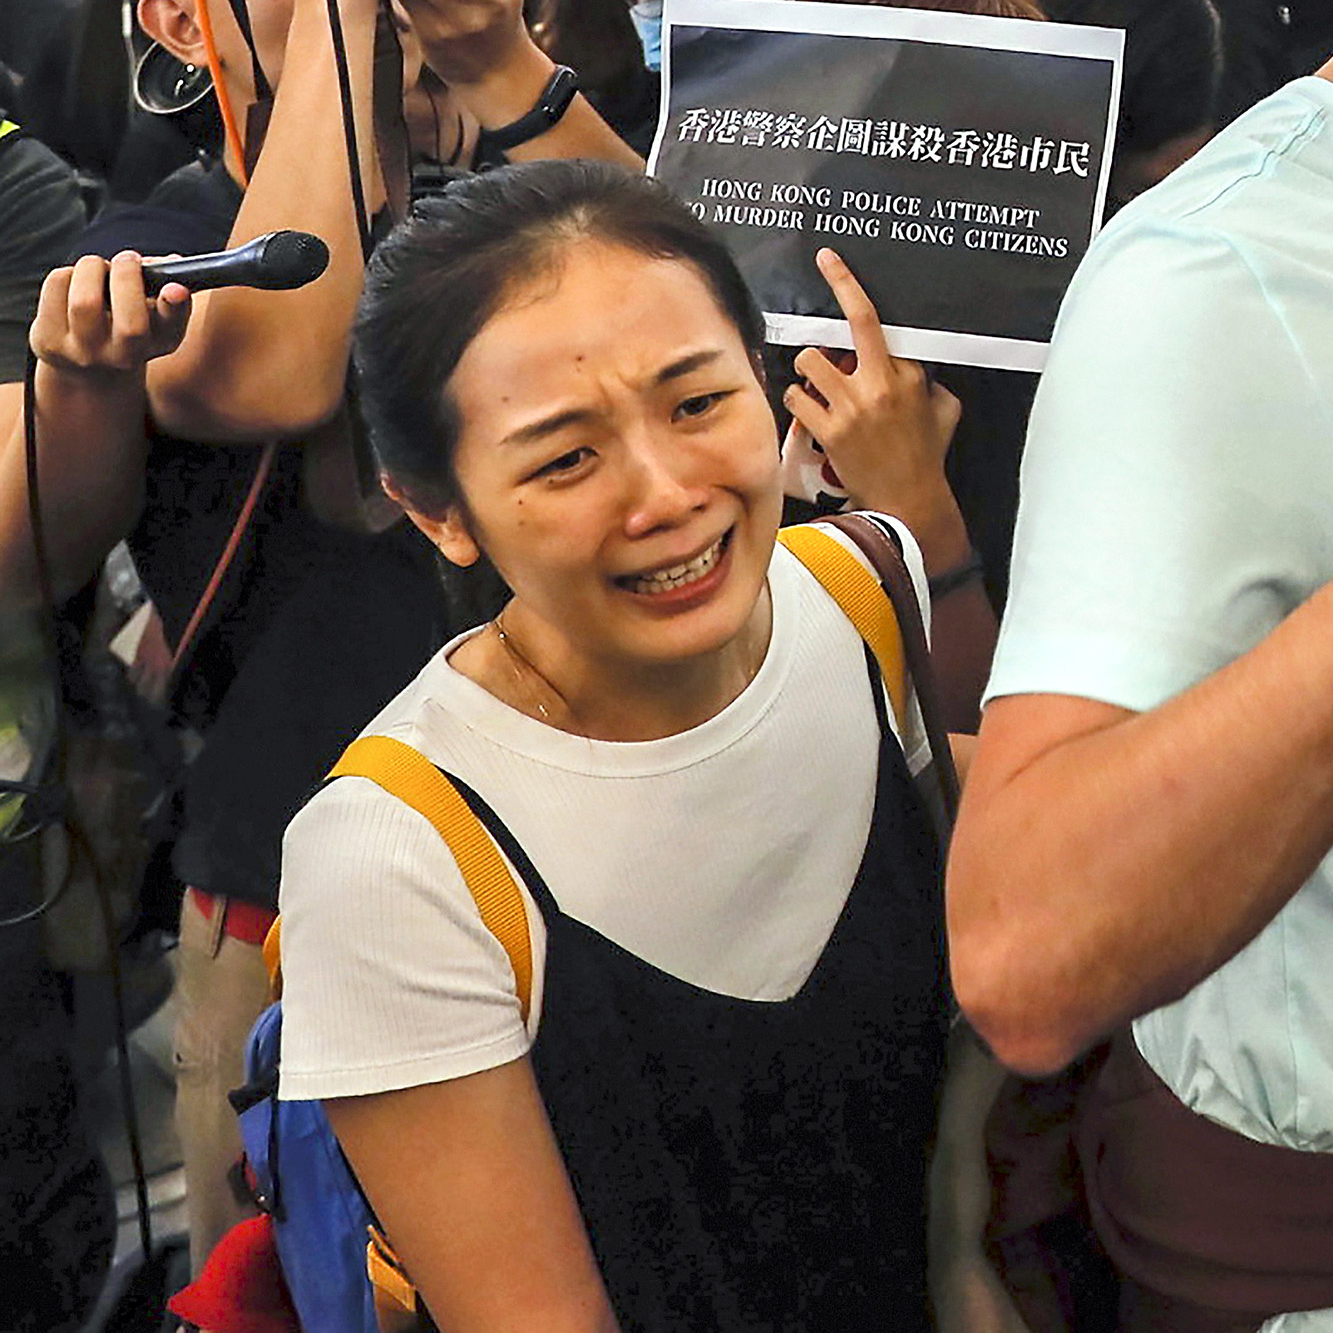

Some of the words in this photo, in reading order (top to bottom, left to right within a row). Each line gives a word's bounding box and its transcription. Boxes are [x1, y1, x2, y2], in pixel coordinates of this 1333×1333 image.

[677, 107, 1091, 178] 香港警察企圖謀殺香港市民
[683, 201, 706, 221] O
[713, 204, 804, 230] MURDER
[814, 213, 880, 238] HONG
[890, 221, 955, 246] KONG
[964, 229, 1069, 258] CITIZENS
[701, 178, 763, 203] HONG
[770, 183, 832, 207] KONG
[841, 190, 921, 216] POLICE
[930, 200, 1041, 229] ATTEMPT
